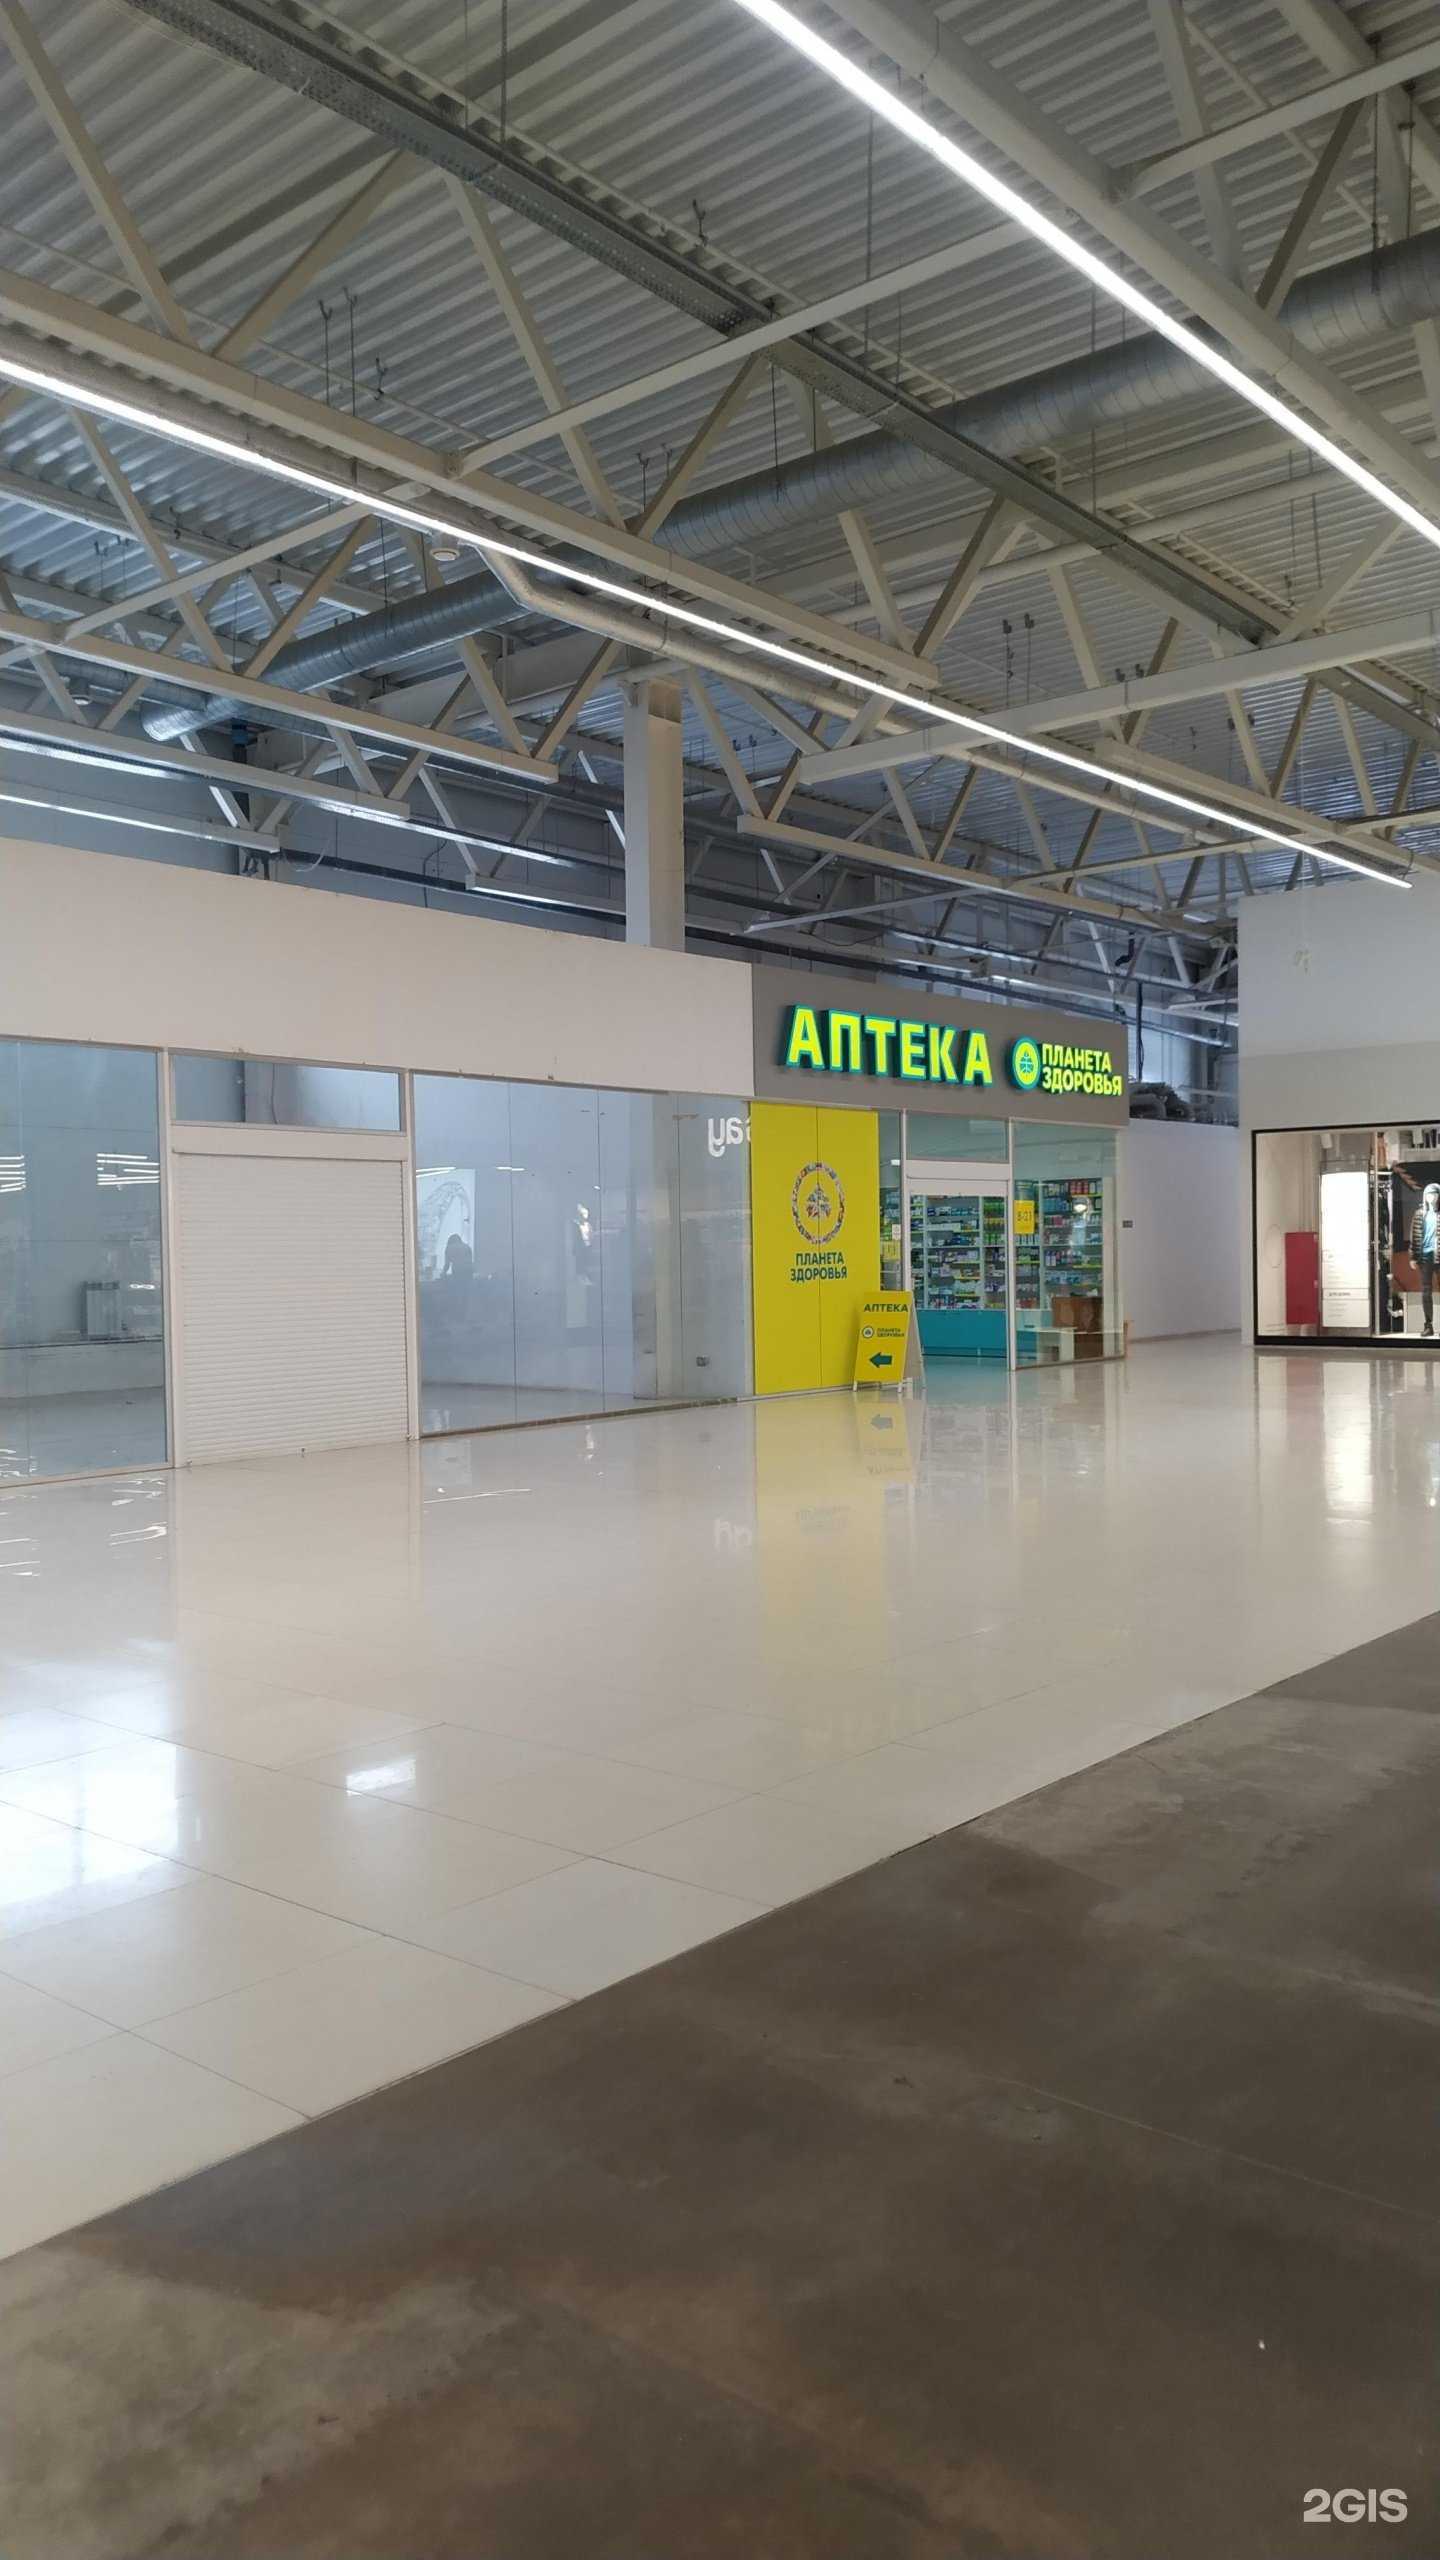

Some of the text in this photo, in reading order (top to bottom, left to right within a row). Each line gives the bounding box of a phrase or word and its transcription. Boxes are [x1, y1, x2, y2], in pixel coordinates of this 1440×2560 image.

[785, 1005, 995, 1087] АПТЕКА
[1041, 1043, 1112, 1073] ПЛАНЕТА
[1041, 1066, 1123, 1096] ЗДОРОВЬЯ
[796, 1251, 845, 1266] ПЛАНЕТА
[790, 1266, 848, 1283] ЗДОРОВЬЯ
[863, 1303, 909, 1313] АПТЕКА
